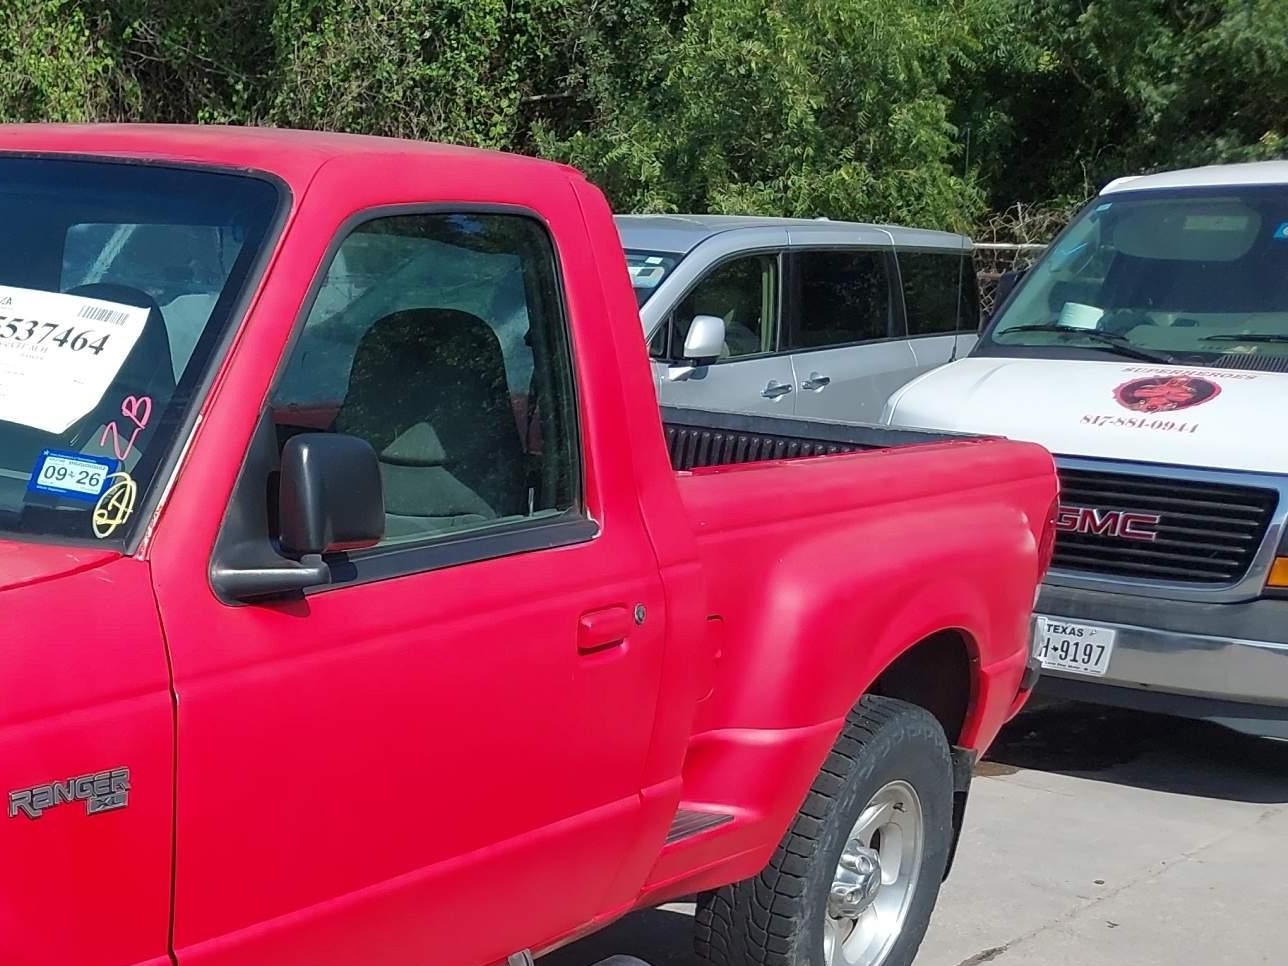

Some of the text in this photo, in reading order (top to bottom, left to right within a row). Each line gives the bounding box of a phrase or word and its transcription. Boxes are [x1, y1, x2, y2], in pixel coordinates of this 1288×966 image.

[1079, 414, 1200, 434] 817-881-0944
[44, 465, 101, 487] 09 26
[1055, 505, 1161, 540] GMC
[1046, 623, 1084, 637] TEXAS
[8, 766, 131, 820] RANGER
